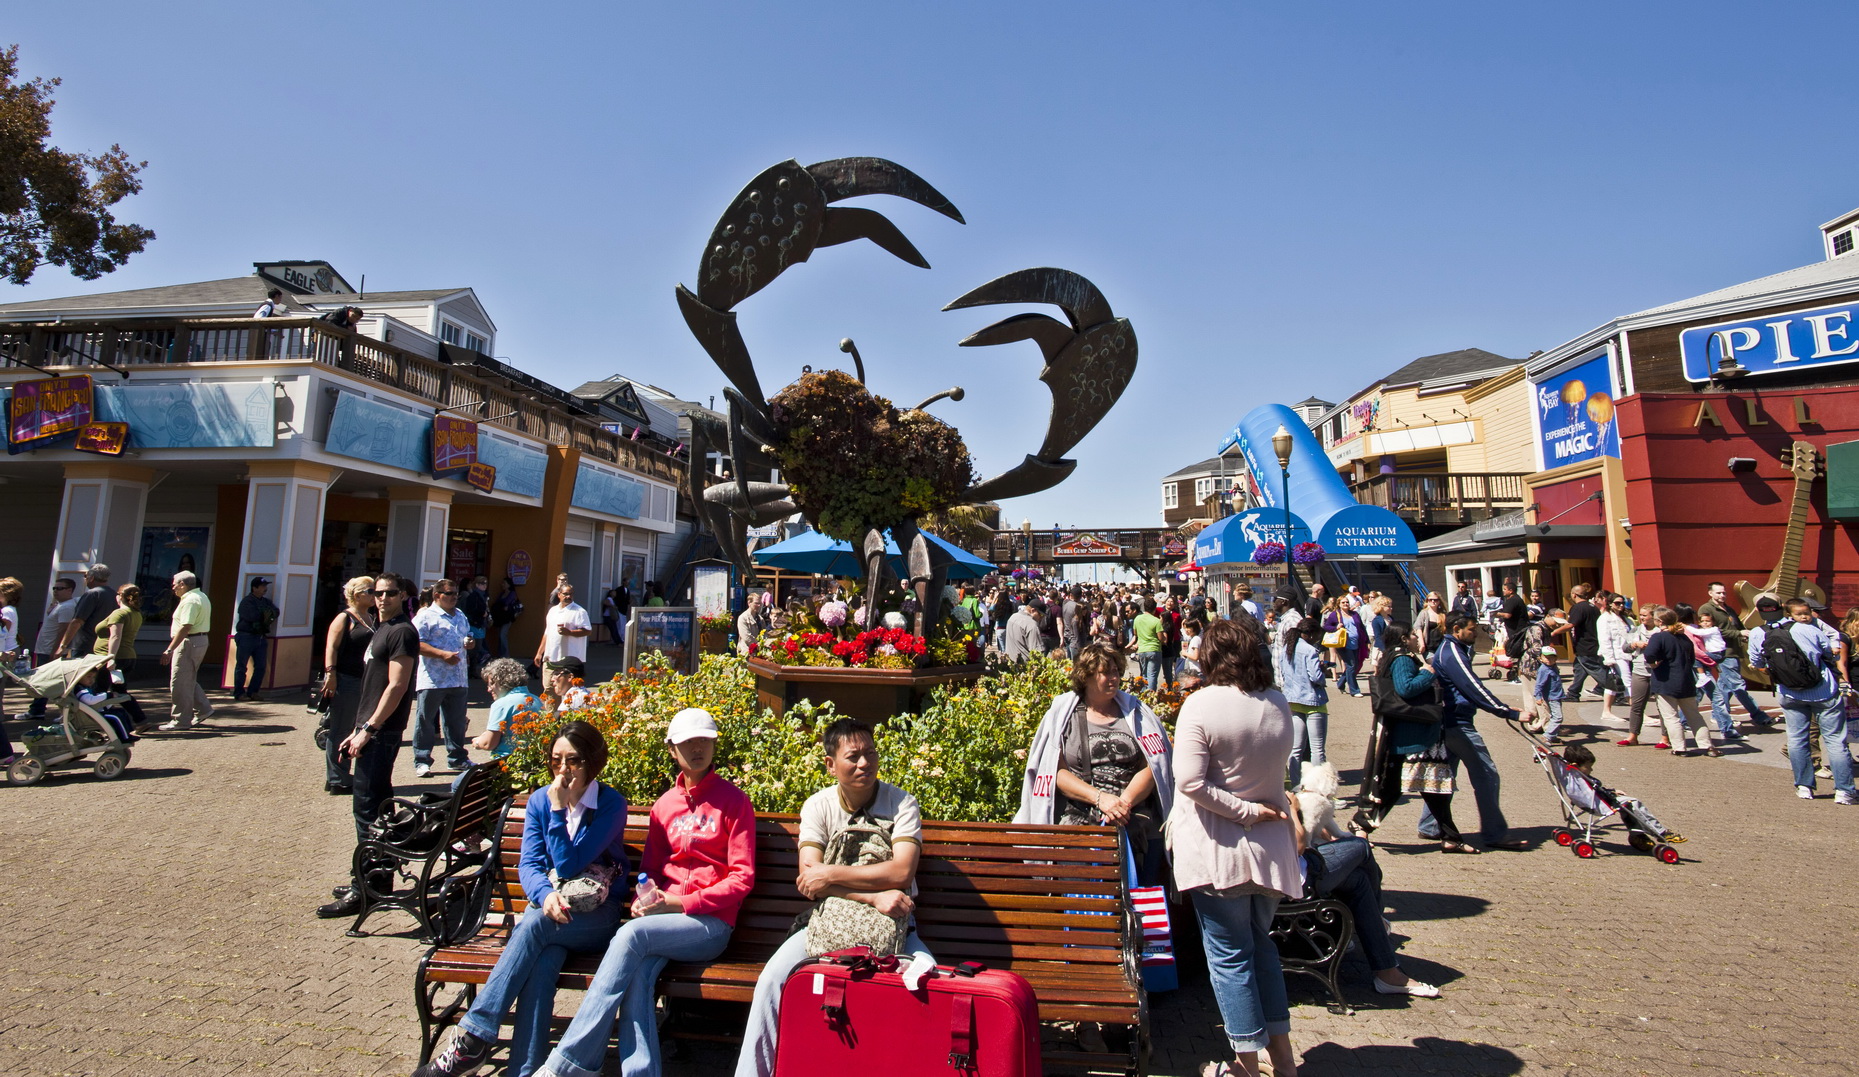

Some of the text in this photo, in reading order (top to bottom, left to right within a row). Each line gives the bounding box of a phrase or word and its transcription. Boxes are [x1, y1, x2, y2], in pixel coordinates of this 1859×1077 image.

[284, 267, 315, 292] EAGLE
[1714, 310, 1859, 372] PIE
[40, 379, 69, 393] ONLY IN
[499, 363, 585, 407] BREAKFAST LUNCH DINNER
[15, 386, 89, 417] SAN FRANCISCO
[1548, 397, 1559, 409] BAY
[1694, 397, 1818, 427] ALL
[1545, 421, 1587, 441] EXPERIENCE THE
[1555, 433, 1594, 459] MAGIC
[1335, 526, 1397, 536] AQUARIUM
[1493, 515, 1508, 530] Rock
[1336, 538, 1397, 547] ENTRANCE
[453, 548, 474, 558] Sale
[640, 615, 651, 623] Your
[668, 615, 690, 623] Memories
